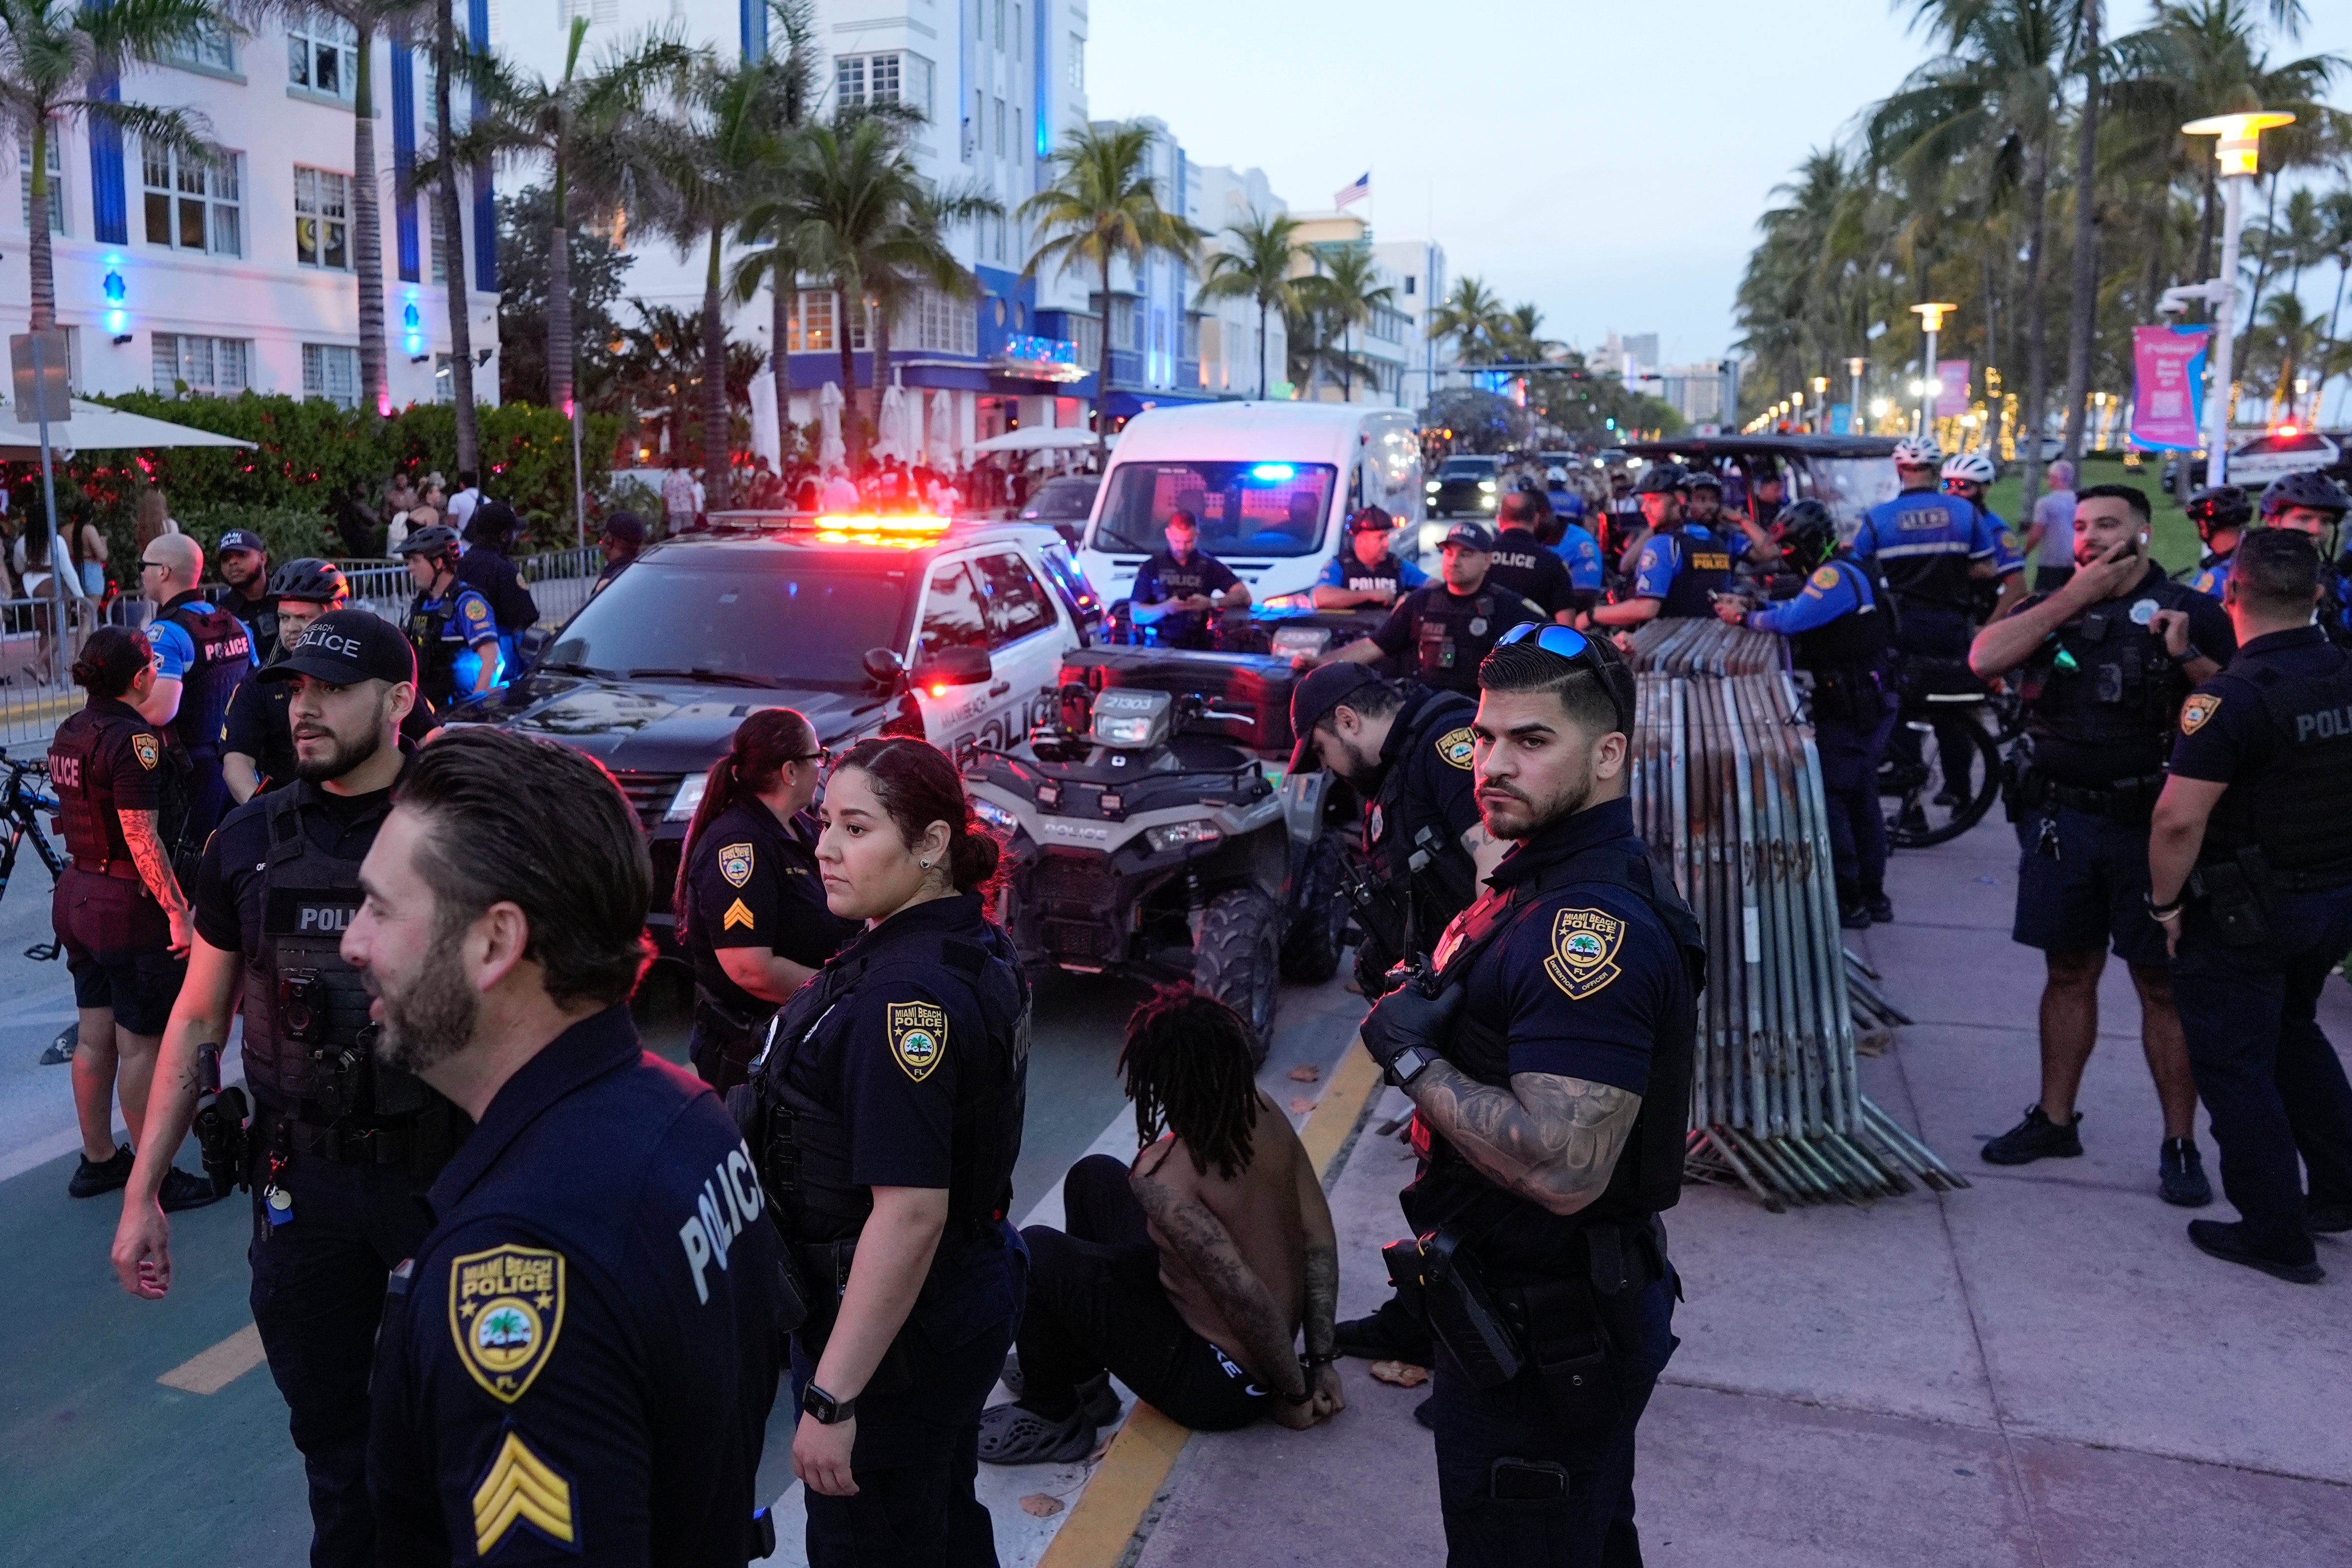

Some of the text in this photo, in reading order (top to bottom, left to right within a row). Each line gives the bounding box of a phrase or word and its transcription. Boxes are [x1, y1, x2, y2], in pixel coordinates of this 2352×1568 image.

[1492, 551, 1536, 569] OLICE
[205, 637, 249, 661] POLICE
[295, 631, 362, 659] OLICE
[2296, 706, 2352, 742] POLI
[49, 754, 79, 787] OLICE
[723, 851, 750, 860] POLICE
[300, 908, 356, 930] POLI
[1561, 919, 1616, 934] POLICE
[1564, 912, 1617, 927] MIAMI BEACH
[1550, 960, 1609, 991] DETENTION OFFICER
[895, 1007, 942, 1019] MIAMI BEACH
[895, 1017, 943, 1027] POLICE
[462, 1274, 552, 1300] POLICE
